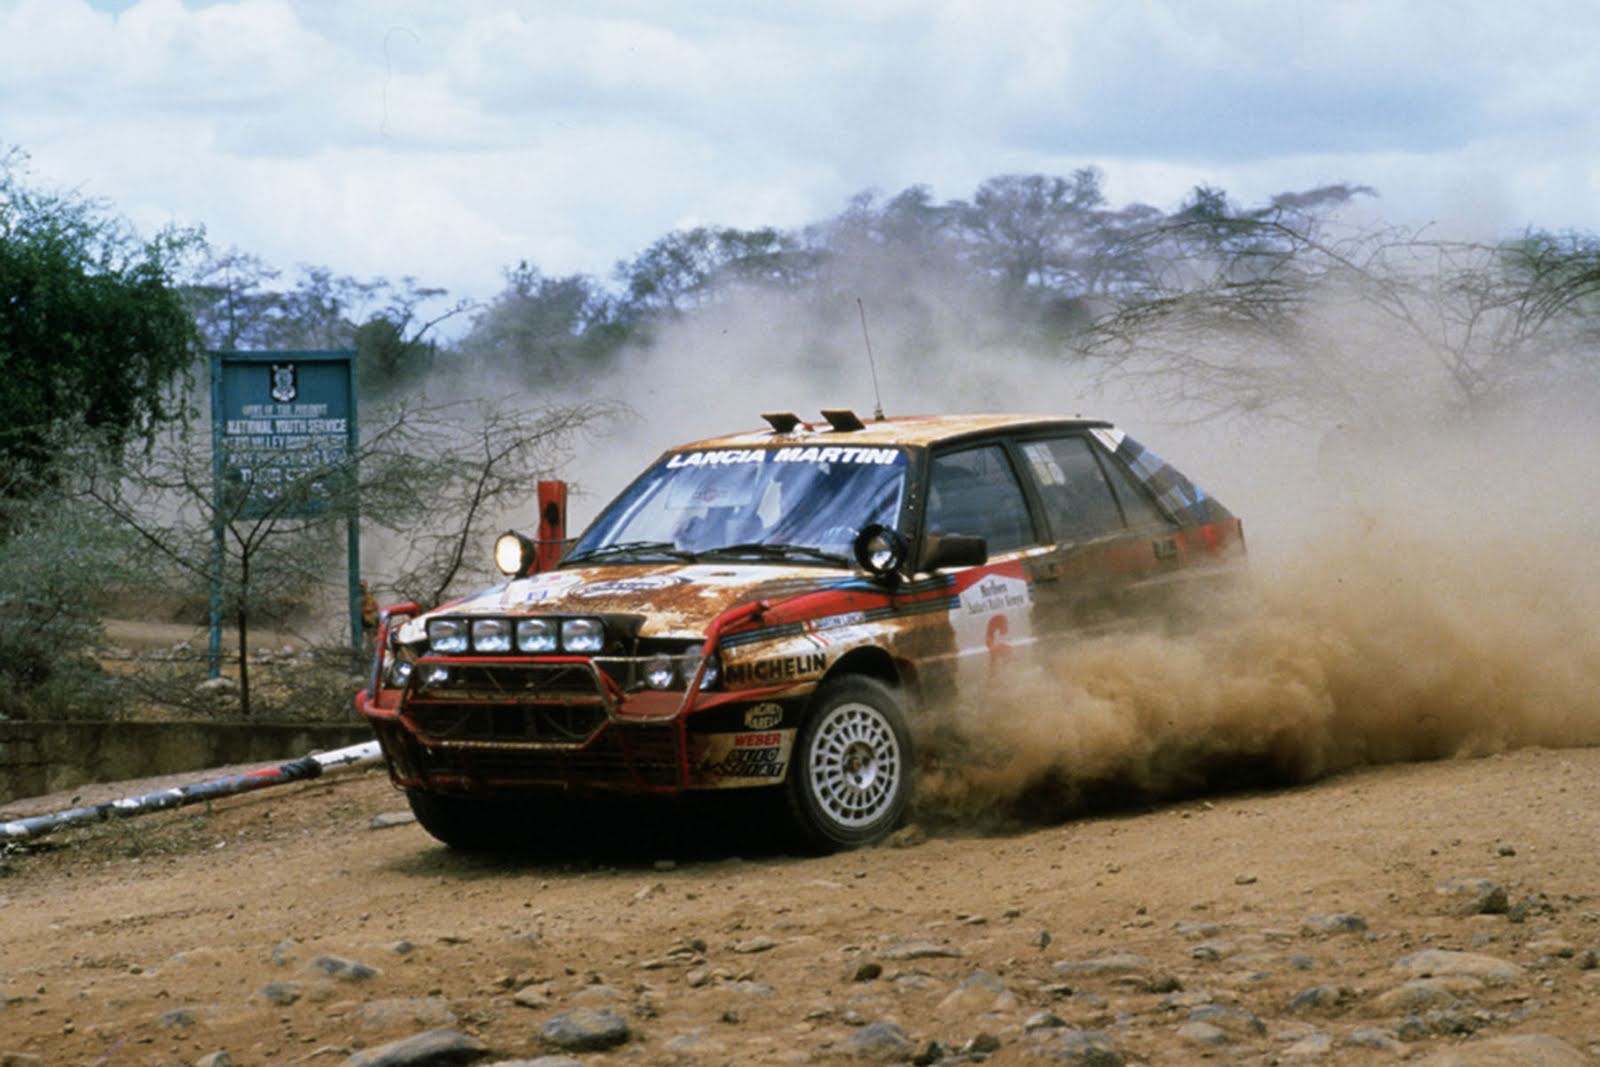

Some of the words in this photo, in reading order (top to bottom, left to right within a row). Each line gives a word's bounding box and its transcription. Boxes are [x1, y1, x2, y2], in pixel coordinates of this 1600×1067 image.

[226, 419, 274, 434] NATIONAL
[275, 419, 307, 433] YOUTH
[308, 418, 347, 433] SERVICE
[666, 449, 768, 469] LANCIA
[773, 446, 900, 465] MARTINI
[724, 652, 828, 684] MICHELIN
[735, 732, 782, 747] WEBER
